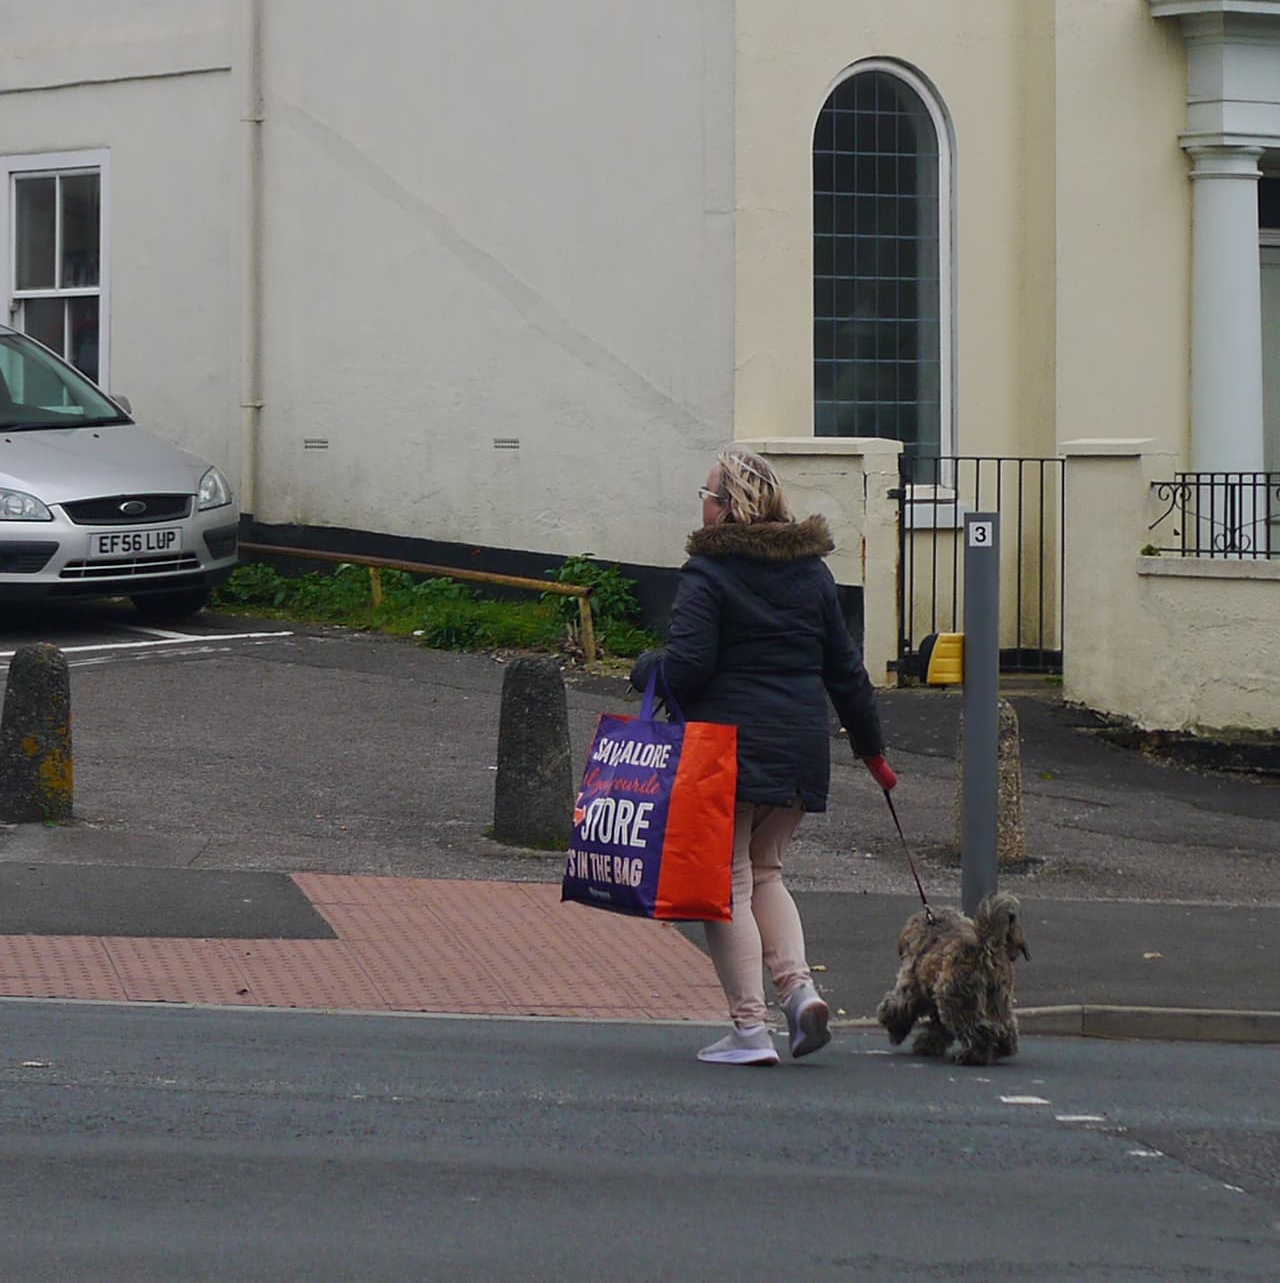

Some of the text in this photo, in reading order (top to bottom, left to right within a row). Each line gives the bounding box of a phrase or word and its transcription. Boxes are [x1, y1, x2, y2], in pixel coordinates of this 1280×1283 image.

[98, 531, 176, 554] EF56 LUP
[975, 526, 987, 543] 3
[577, 850, 589, 879] IN
[589, 853, 613, 884] THE
[613, 856, 644, 887] BAG
